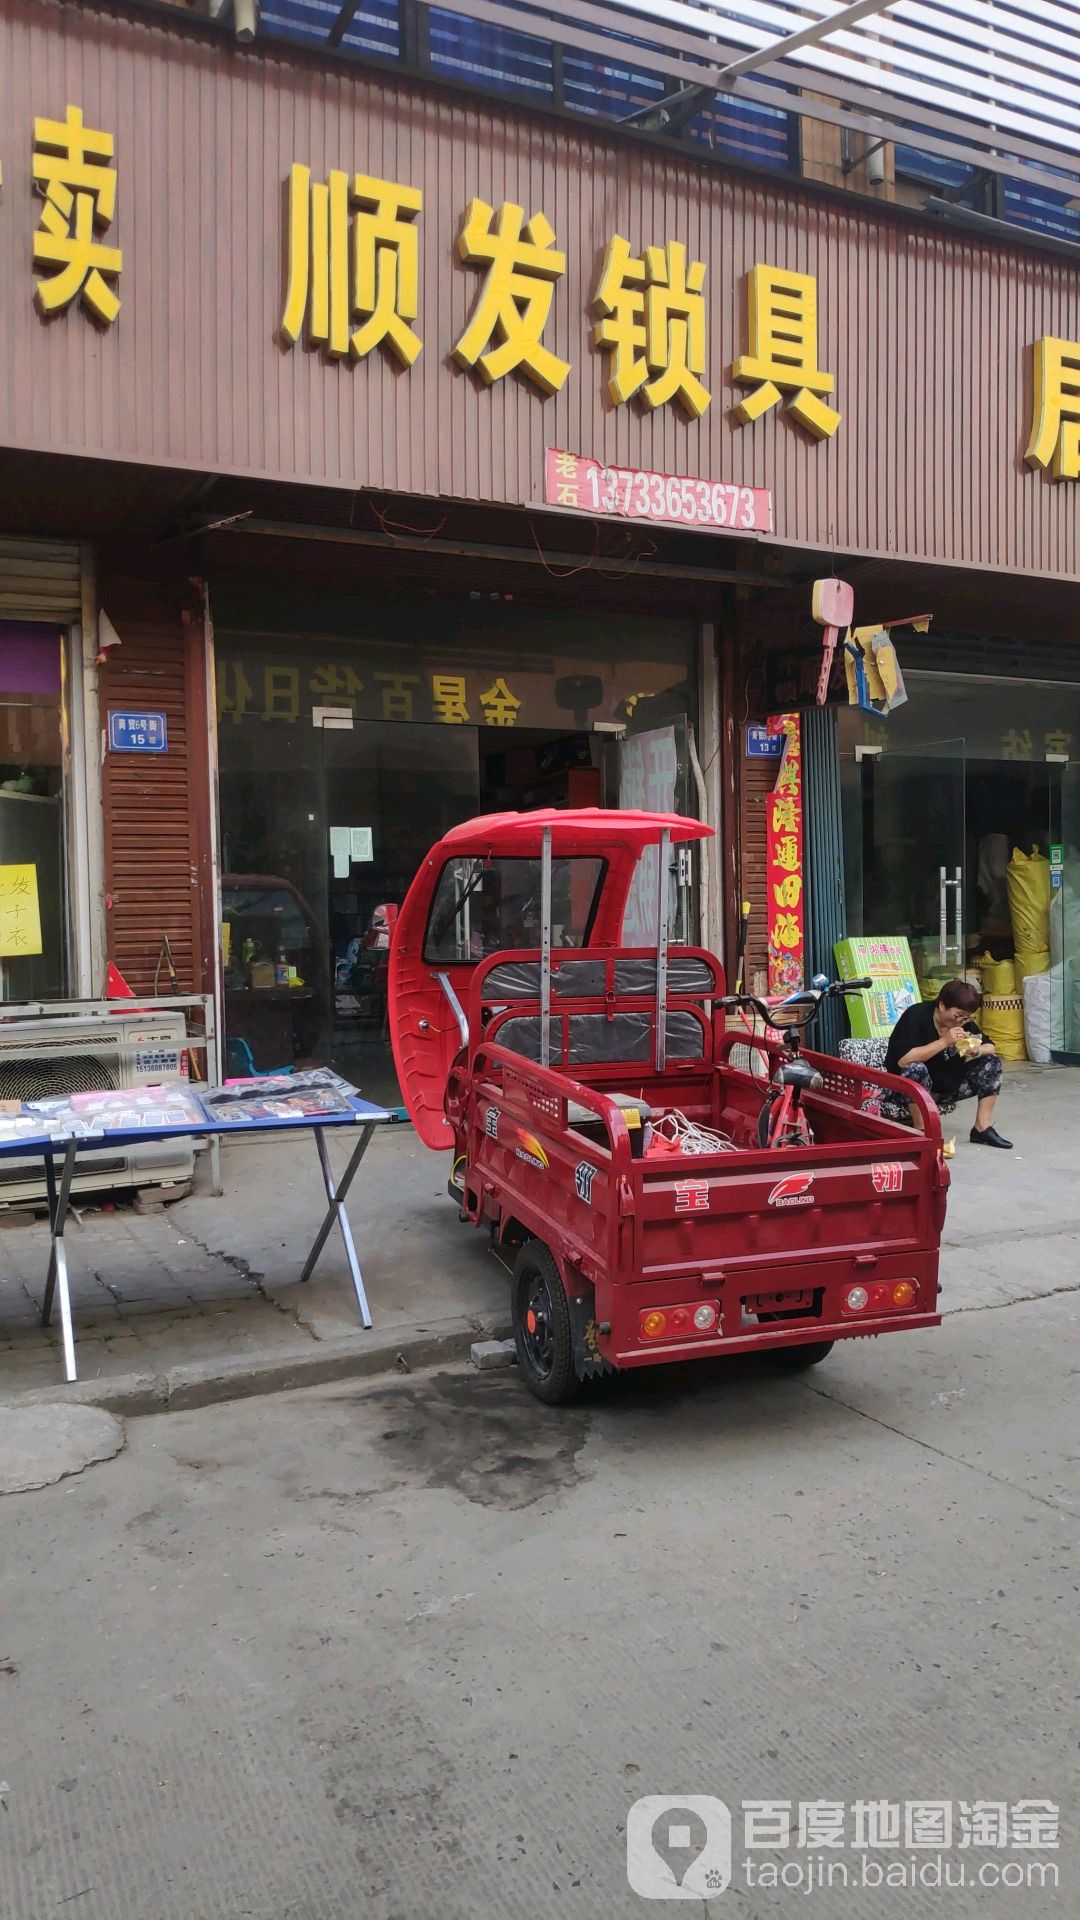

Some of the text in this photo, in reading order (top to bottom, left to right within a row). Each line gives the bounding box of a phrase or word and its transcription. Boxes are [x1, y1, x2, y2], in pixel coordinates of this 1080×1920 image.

[32, 104, 123, 324] 卖
[280, 162, 842, 441] 顺发锁具
[554, 451, 579, 508] 老石
[586, 466, 756, 529] 13733653673
[130, 734, 146, 745] 15
[674, 1179, 710, 1212] 宝
[775, 1195, 815, 1207] BAOLING
